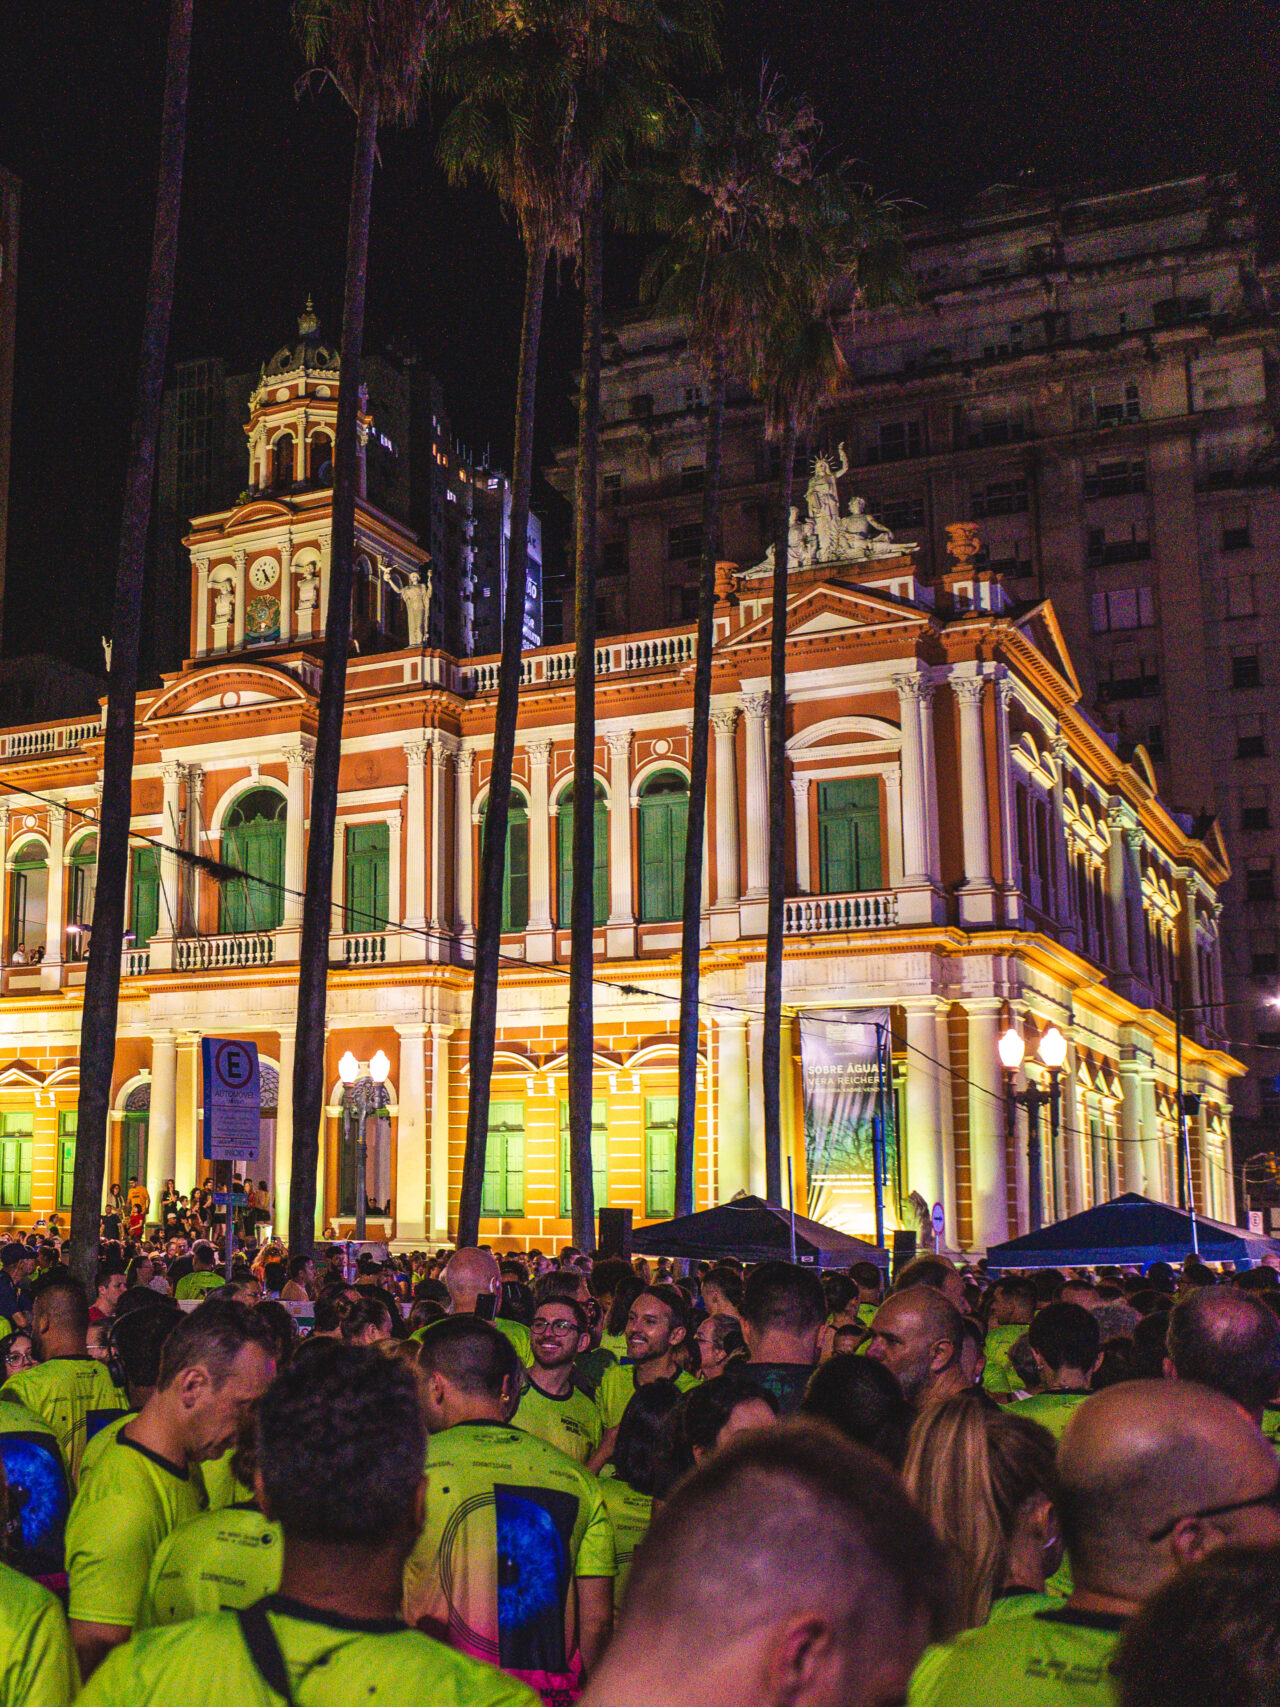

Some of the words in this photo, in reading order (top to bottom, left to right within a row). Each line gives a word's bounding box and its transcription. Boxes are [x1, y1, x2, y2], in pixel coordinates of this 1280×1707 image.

[227, 1052, 242, 1078] E
[808, 1064, 844, 1074] SOBRE
[847, 1062, 886, 1073] ÁGUAS
[808, 1076, 834, 1085] VERA
[838, 1075, 887, 1085] REICHERT
